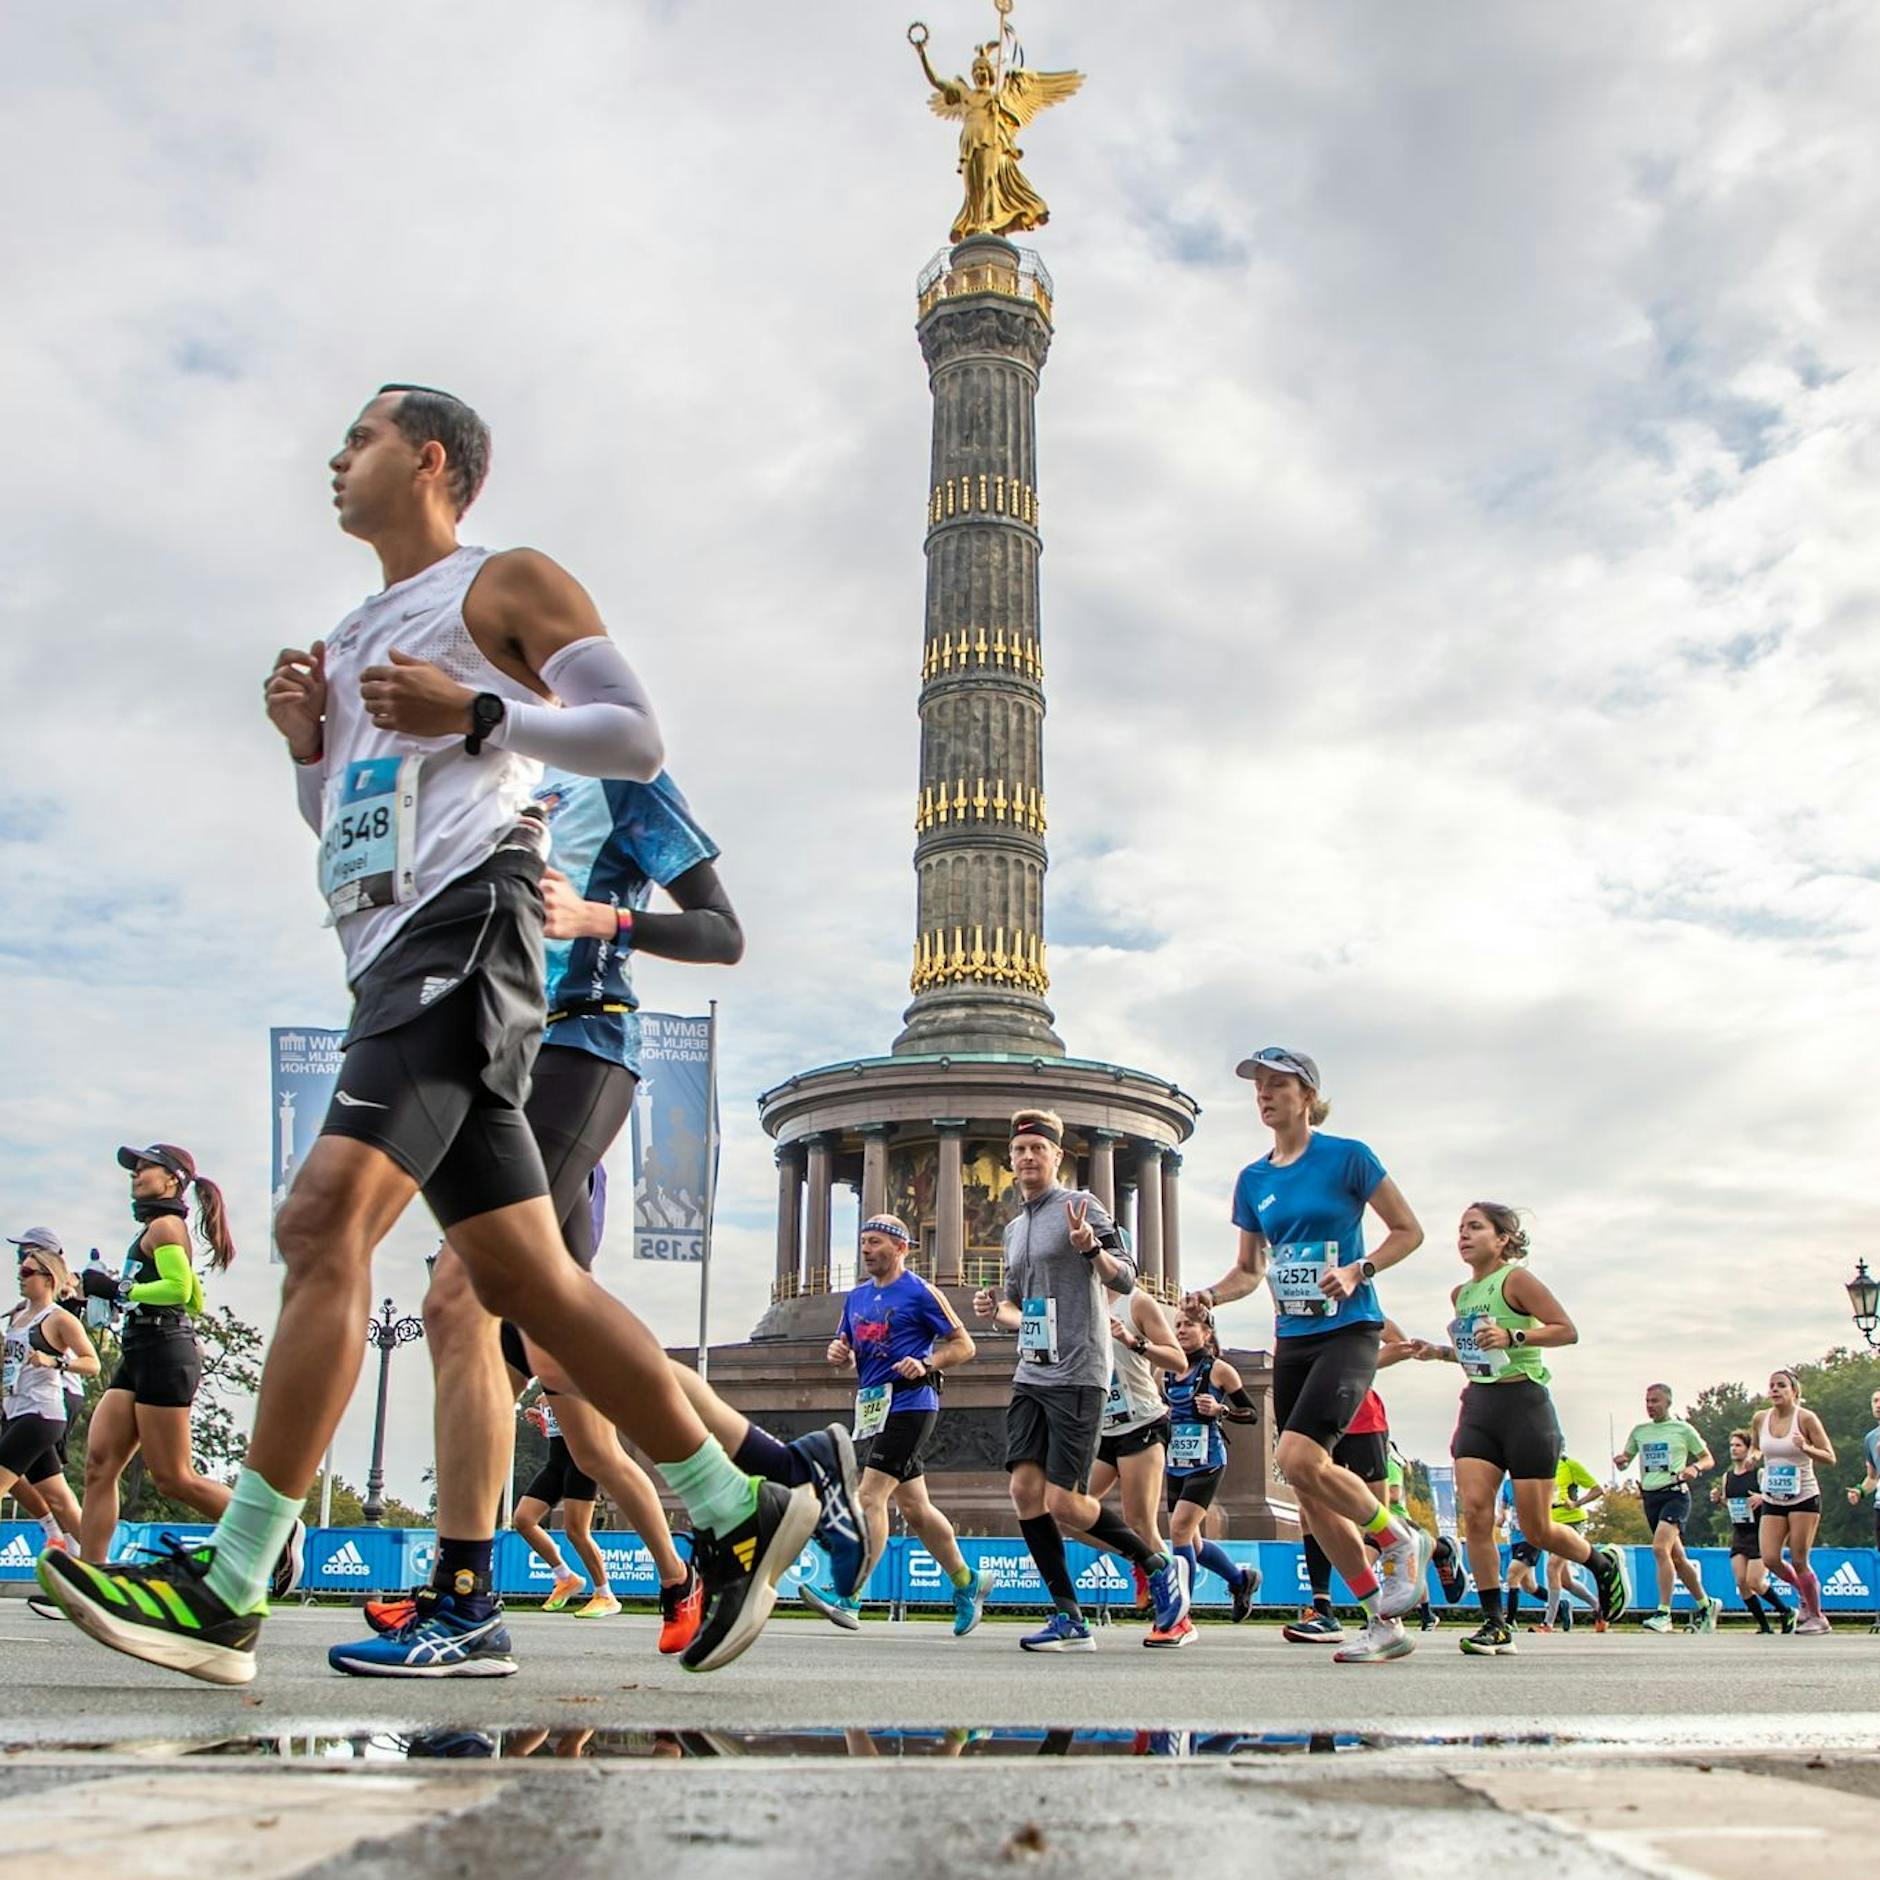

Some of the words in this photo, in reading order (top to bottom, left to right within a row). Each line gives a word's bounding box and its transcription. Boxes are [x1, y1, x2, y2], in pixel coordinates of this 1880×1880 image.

[1277, 1267, 1317, 1284] 12521
[321, 1562, 371, 1576] adidas
[604, 1562, 634, 1571] ERLIN
[979, 1556, 1018, 1569] BMW
[606, 1571, 655, 1581] ARATHON
[993, 1579, 1041, 1589] RATHON
[1075, 1576, 1129, 1590] adidas
[1822, 1583, 1870, 1597] adidas
